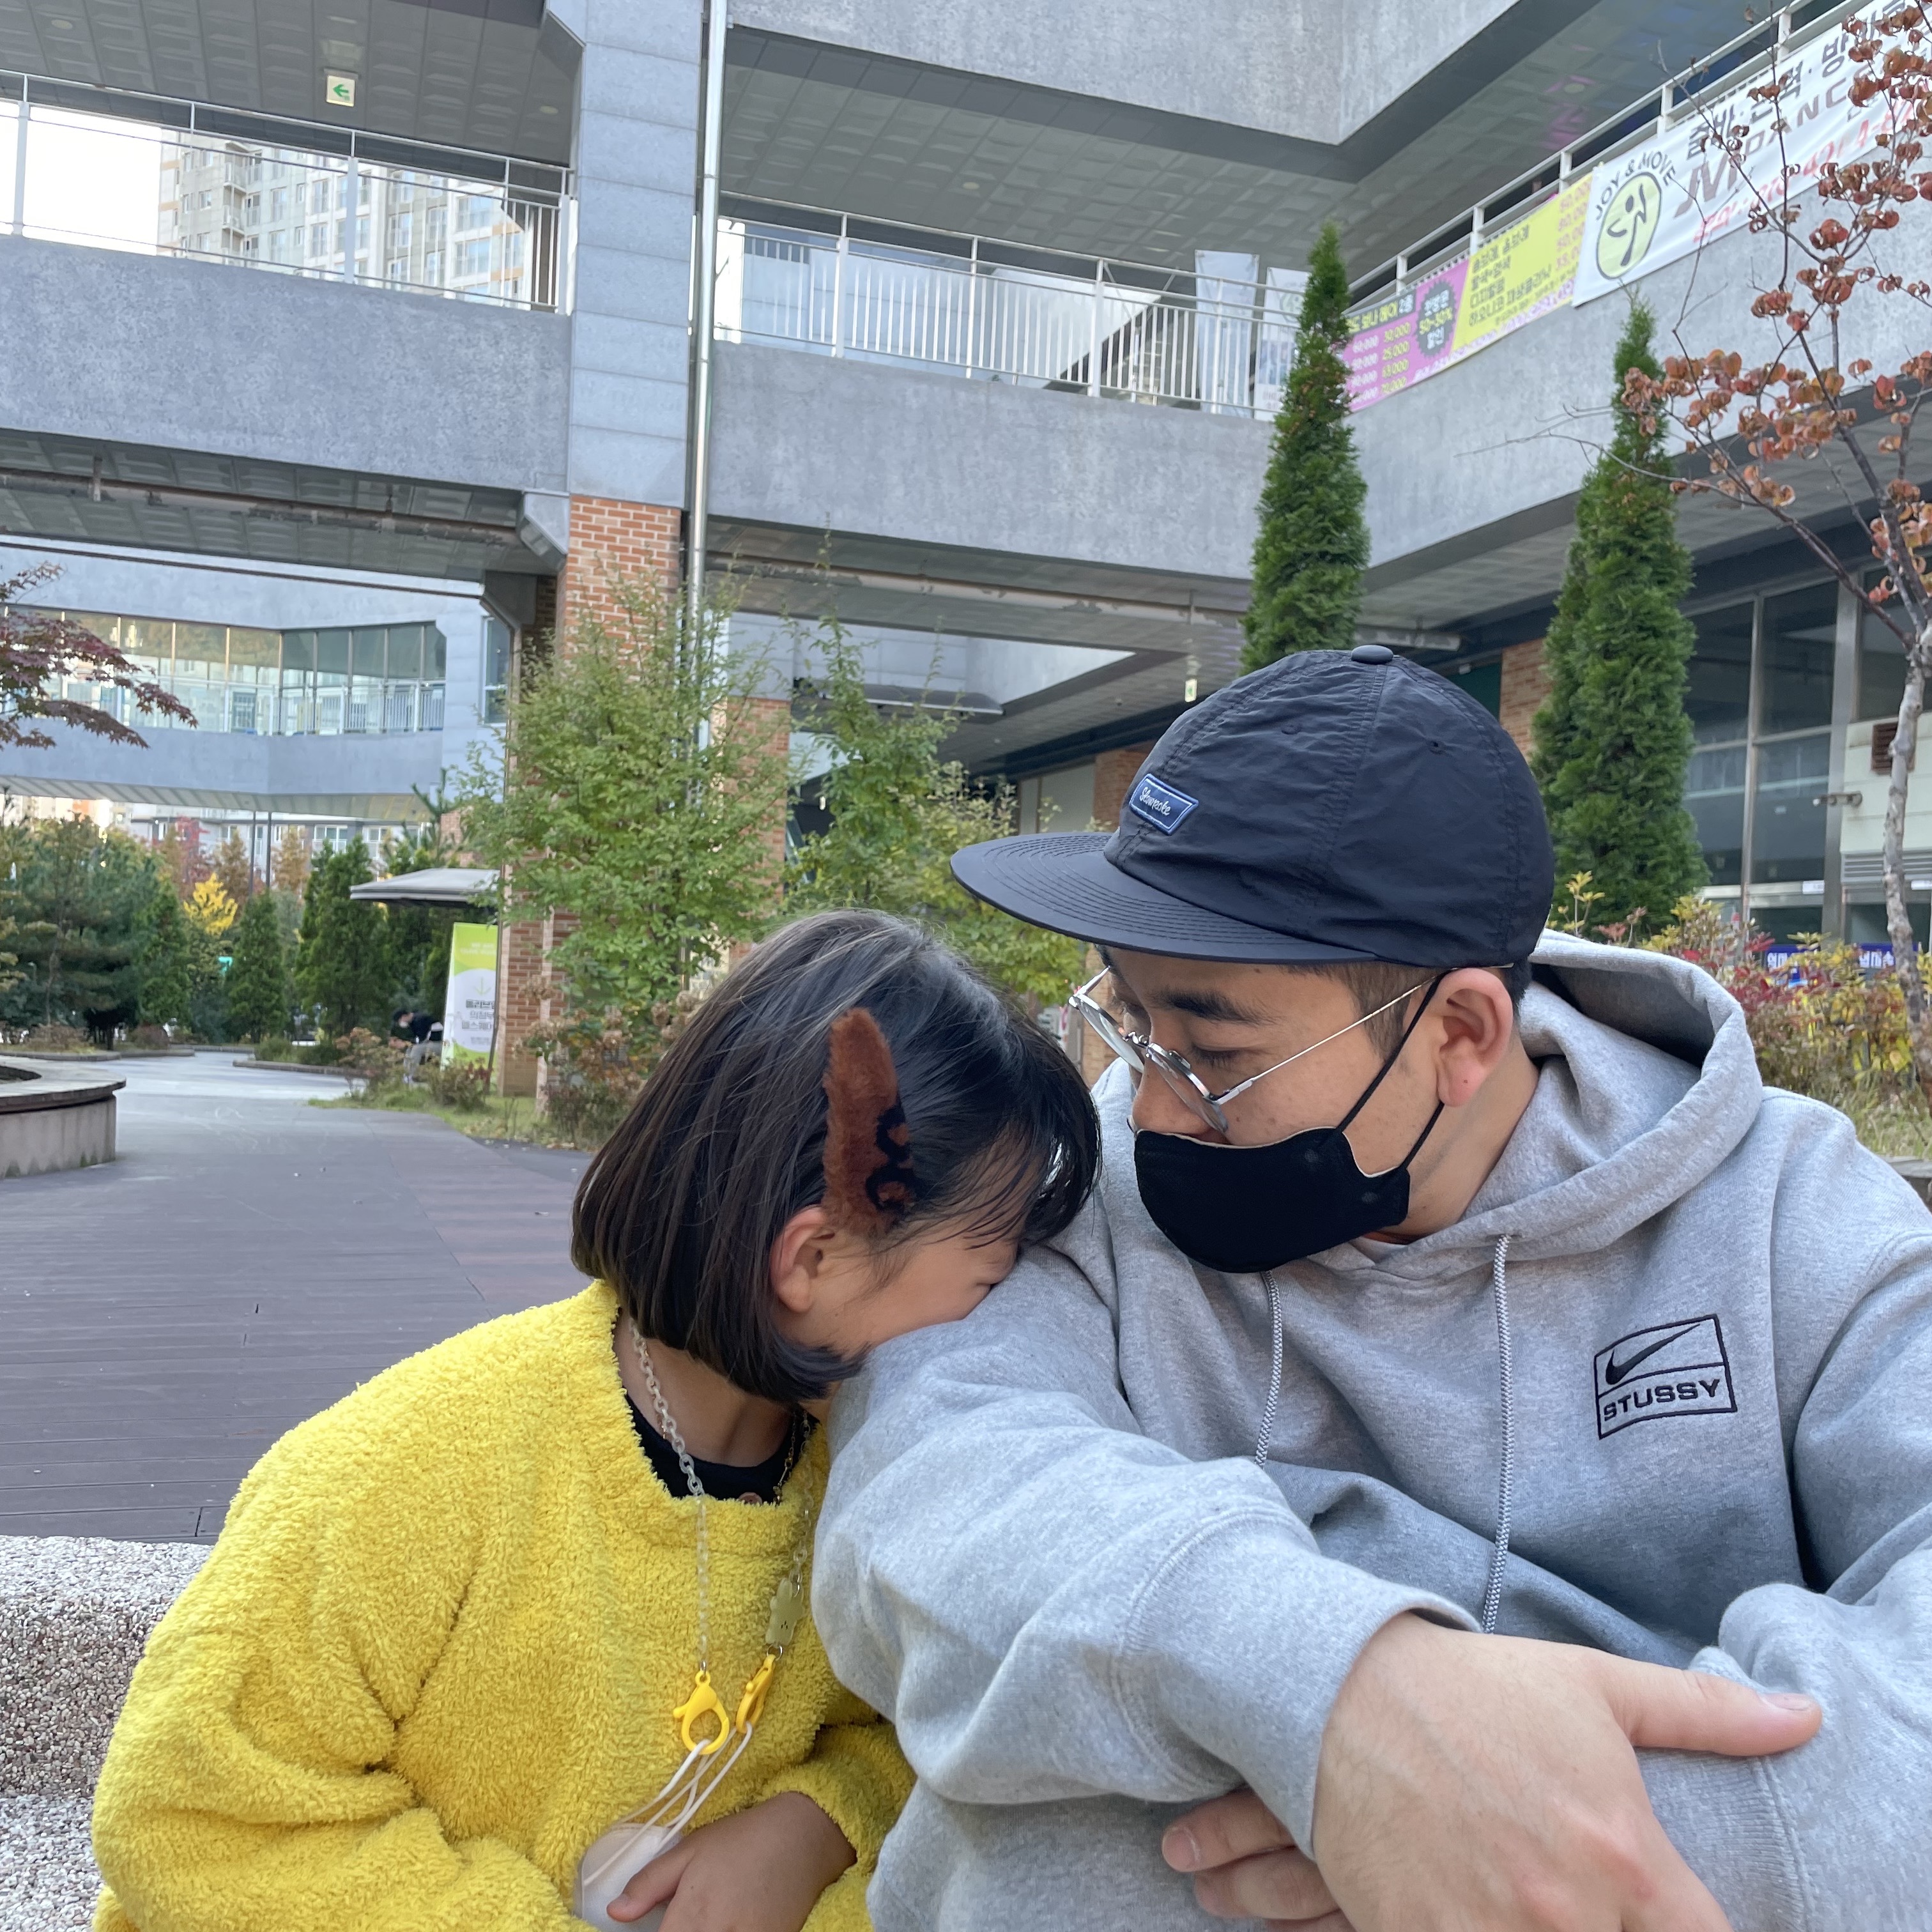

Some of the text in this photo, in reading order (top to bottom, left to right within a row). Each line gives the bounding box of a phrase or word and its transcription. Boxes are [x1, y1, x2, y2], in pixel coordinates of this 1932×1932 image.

[1595, 151, 1677, 221] JOY & MOVE
[1604, 1379, 1720, 1422] STUSSY
